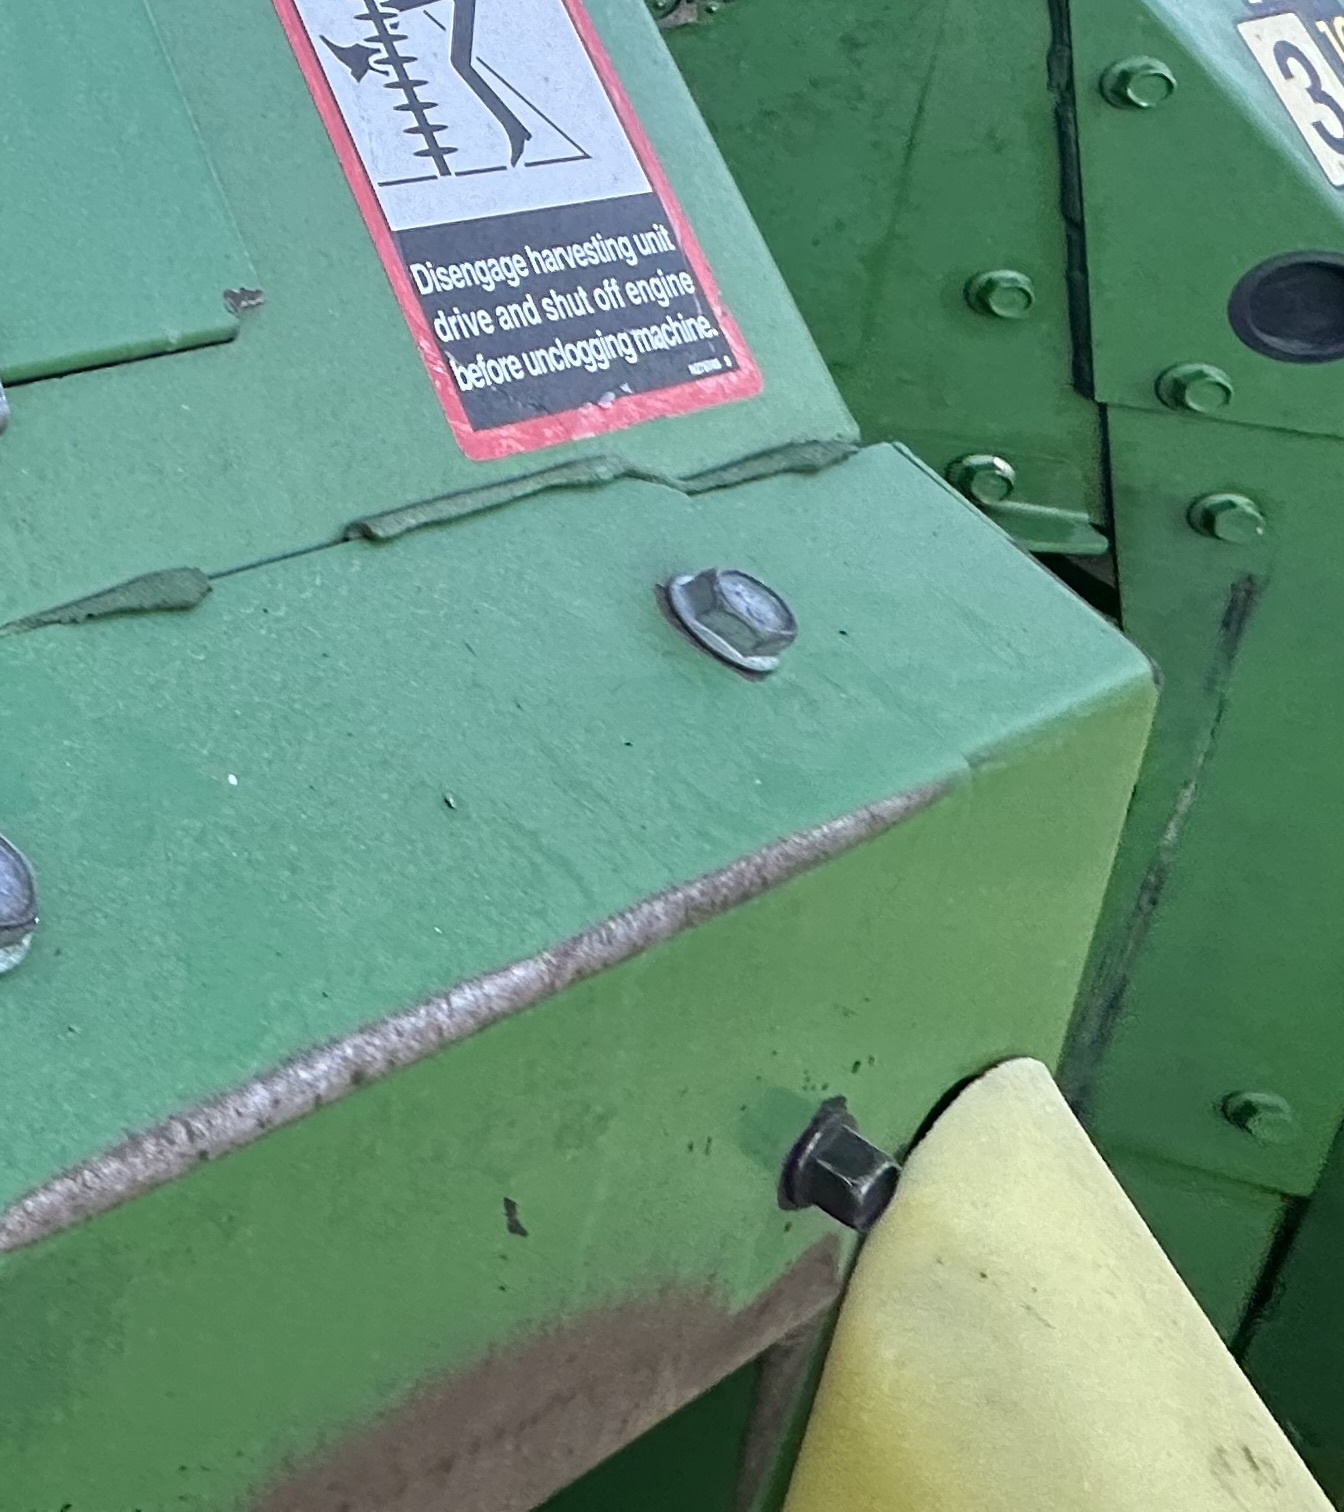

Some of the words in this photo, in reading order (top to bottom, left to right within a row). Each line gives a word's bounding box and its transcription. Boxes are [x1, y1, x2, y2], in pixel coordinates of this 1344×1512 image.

[1273, 40, 1344, 155] 3
[409, 260, 530, 296] Disengage
[523, 244, 639, 277] harvesting
[632, 223, 676, 256] unit
[433, 306, 495, 343] drive
[495, 293, 543, 331] and
[541, 285, 596, 322] shut
[592, 278, 627, 311] off
[624, 268, 696, 308] engine
[449, 352, 525, 392] before
[521, 329, 638, 373] unclogging
[631, 312, 720, 355] machine.
